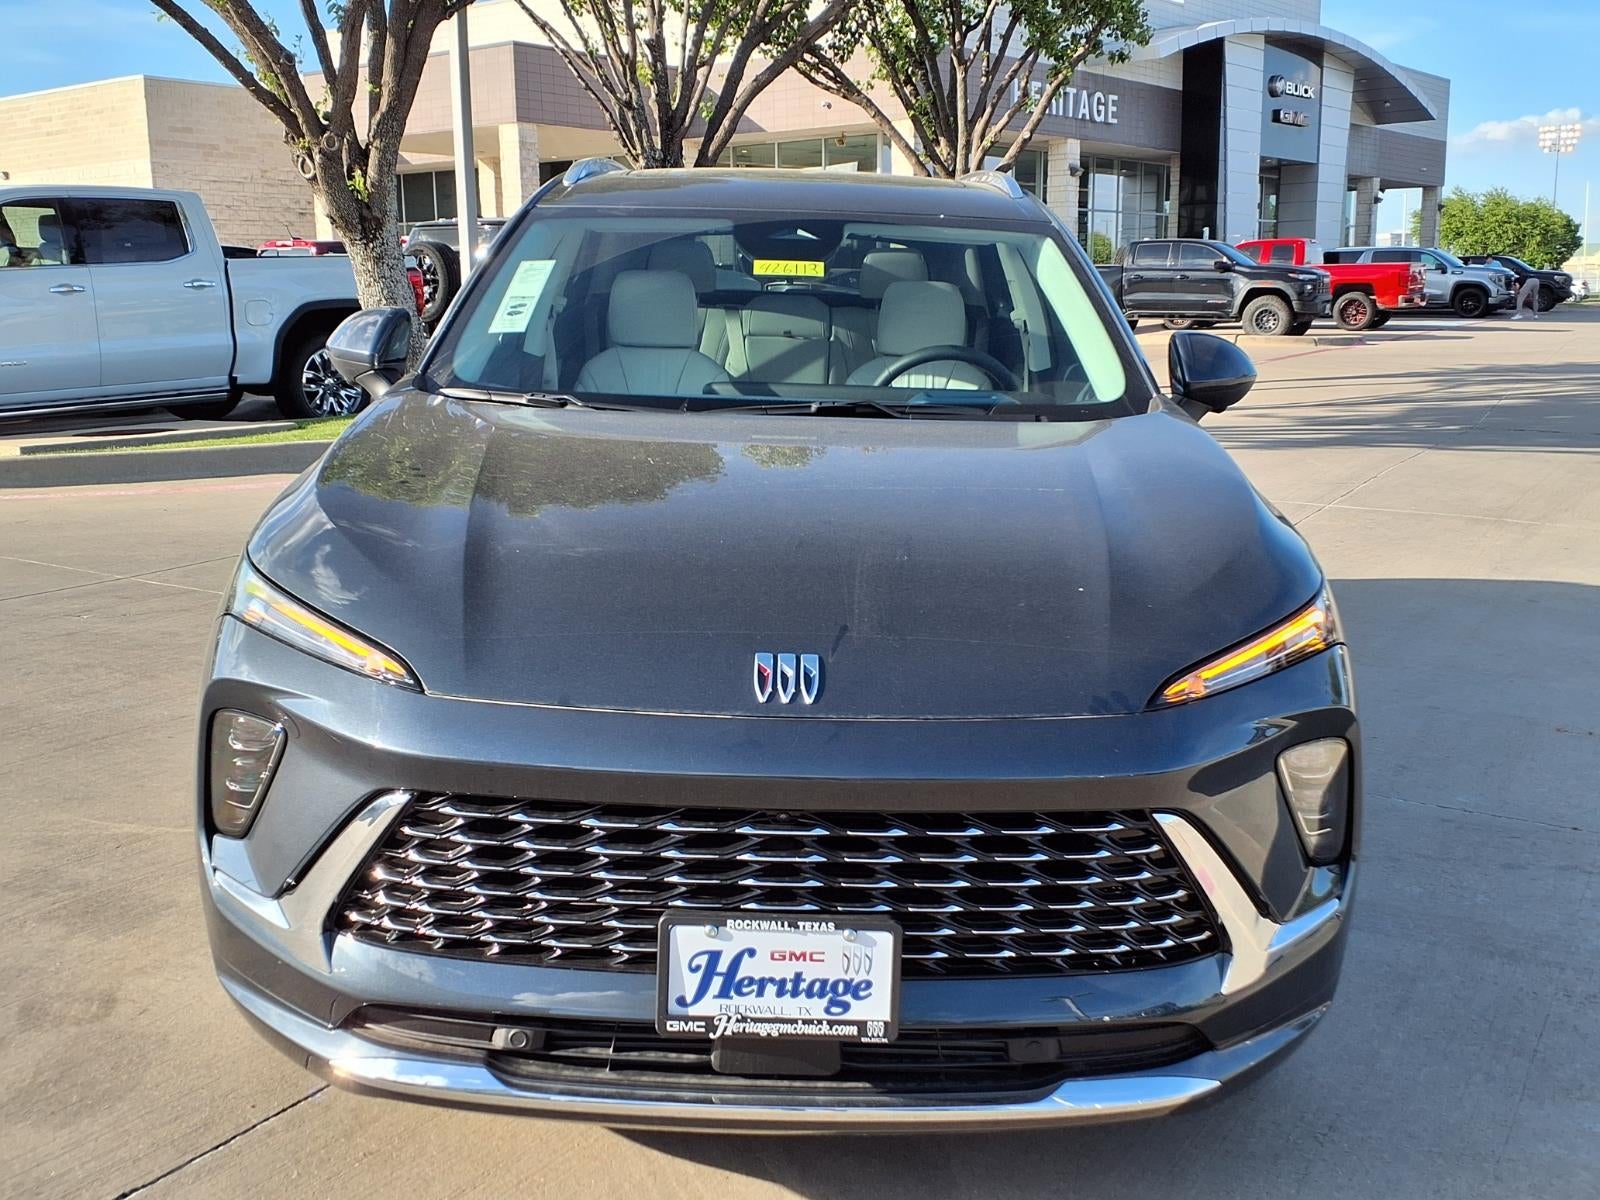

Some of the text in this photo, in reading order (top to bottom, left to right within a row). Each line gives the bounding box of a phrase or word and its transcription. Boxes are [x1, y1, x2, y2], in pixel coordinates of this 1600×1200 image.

[1285, 81, 1315, 99] BUICK
[726, 919, 836, 932] ROCKWALL, TEXAS
[769, 950, 826, 963] GMC
[674, 946, 874, 1017] Heritage
[796, 1006, 813, 1017] TX
[666, 1014, 858, 1039] GMC Heritagegmcbuick.com
